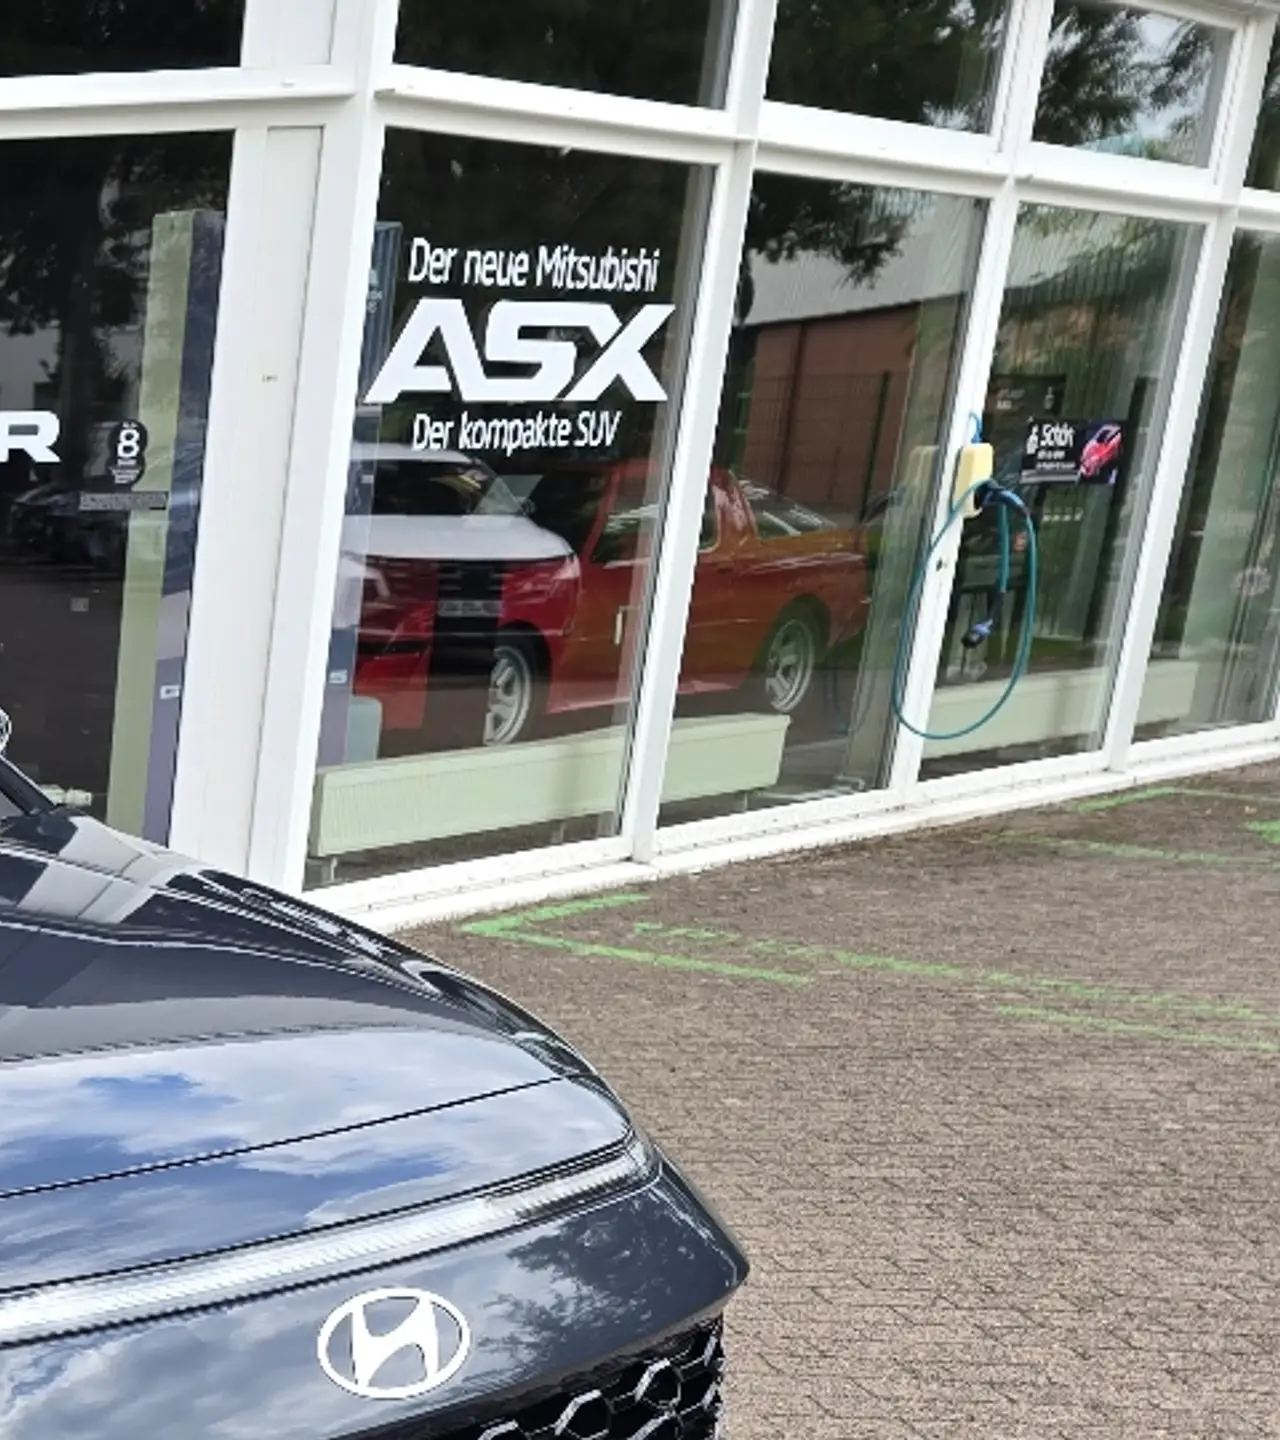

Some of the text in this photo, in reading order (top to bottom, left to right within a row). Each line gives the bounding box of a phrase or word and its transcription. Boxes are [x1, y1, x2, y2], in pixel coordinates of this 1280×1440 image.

[408, 237, 660, 292] Der neue Mitsubishi
[363, 297, 676, 403] ASX
[413, 410, 622, 457] Der kompakte SUV
